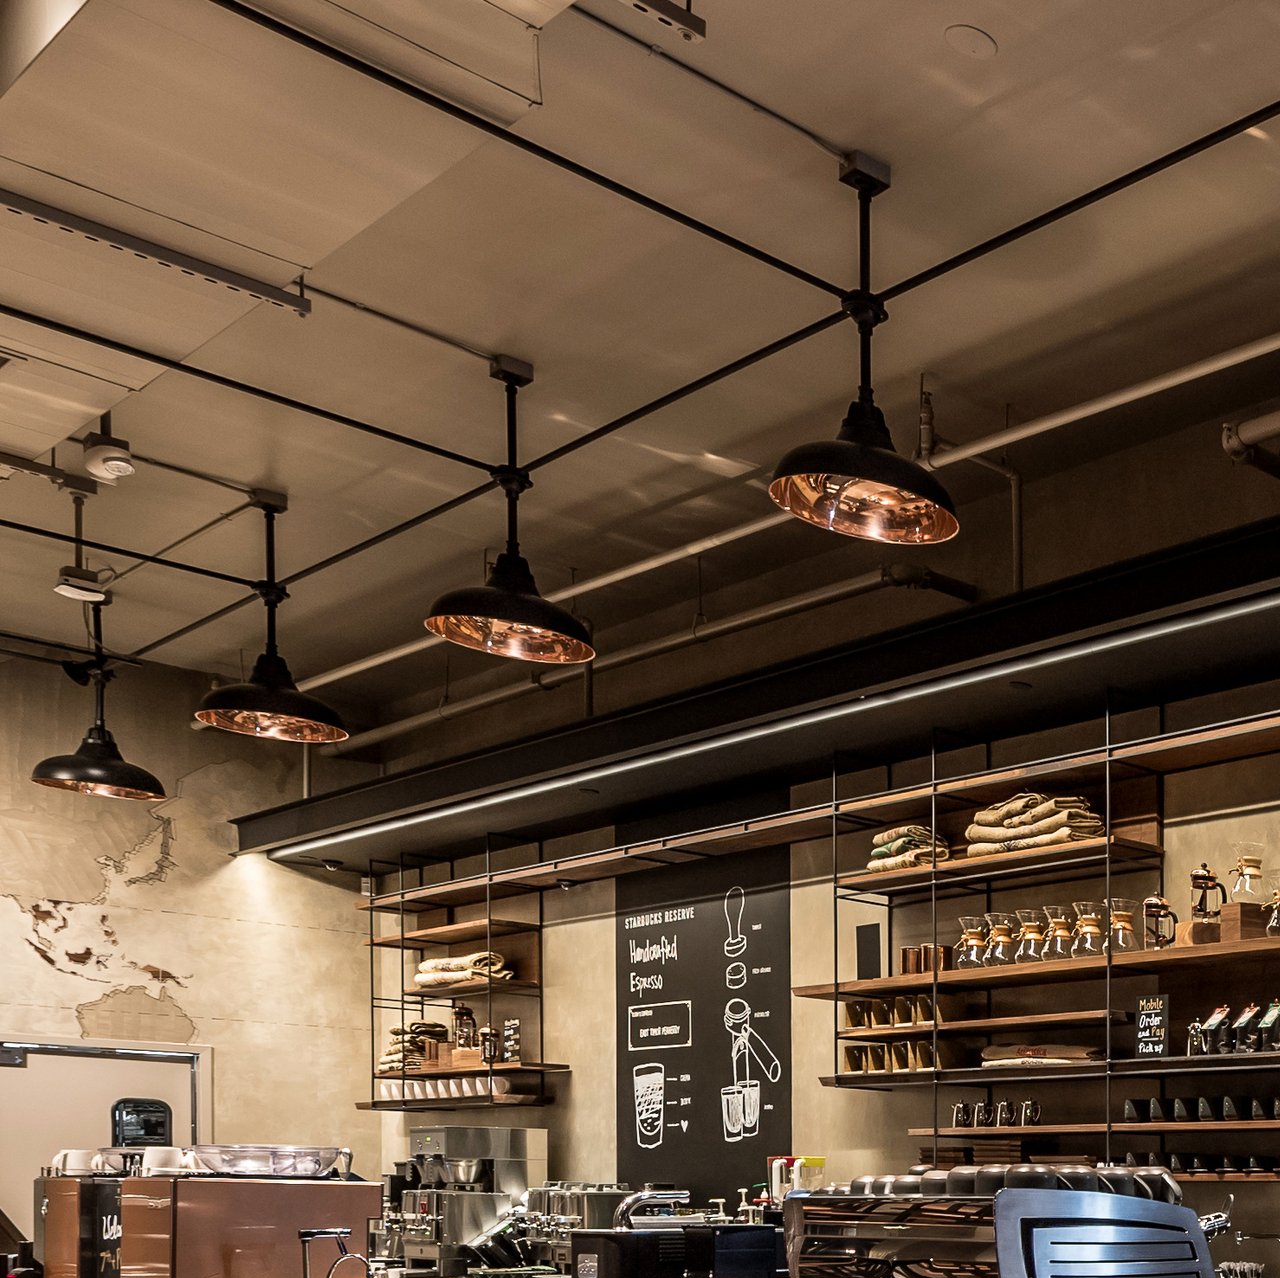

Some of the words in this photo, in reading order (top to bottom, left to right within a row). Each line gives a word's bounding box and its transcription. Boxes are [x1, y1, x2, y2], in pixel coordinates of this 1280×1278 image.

[625, 912, 662, 929] STARBUCKS
[664, 907, 695, 922] RESERVE
[630, 972, 663, 998] Espresso
[1139, 997, 1163, 1010] Mobile
[1139, 1013, 1162, 1028] Order
[1151, 1026, 1165, 1040] Pay
